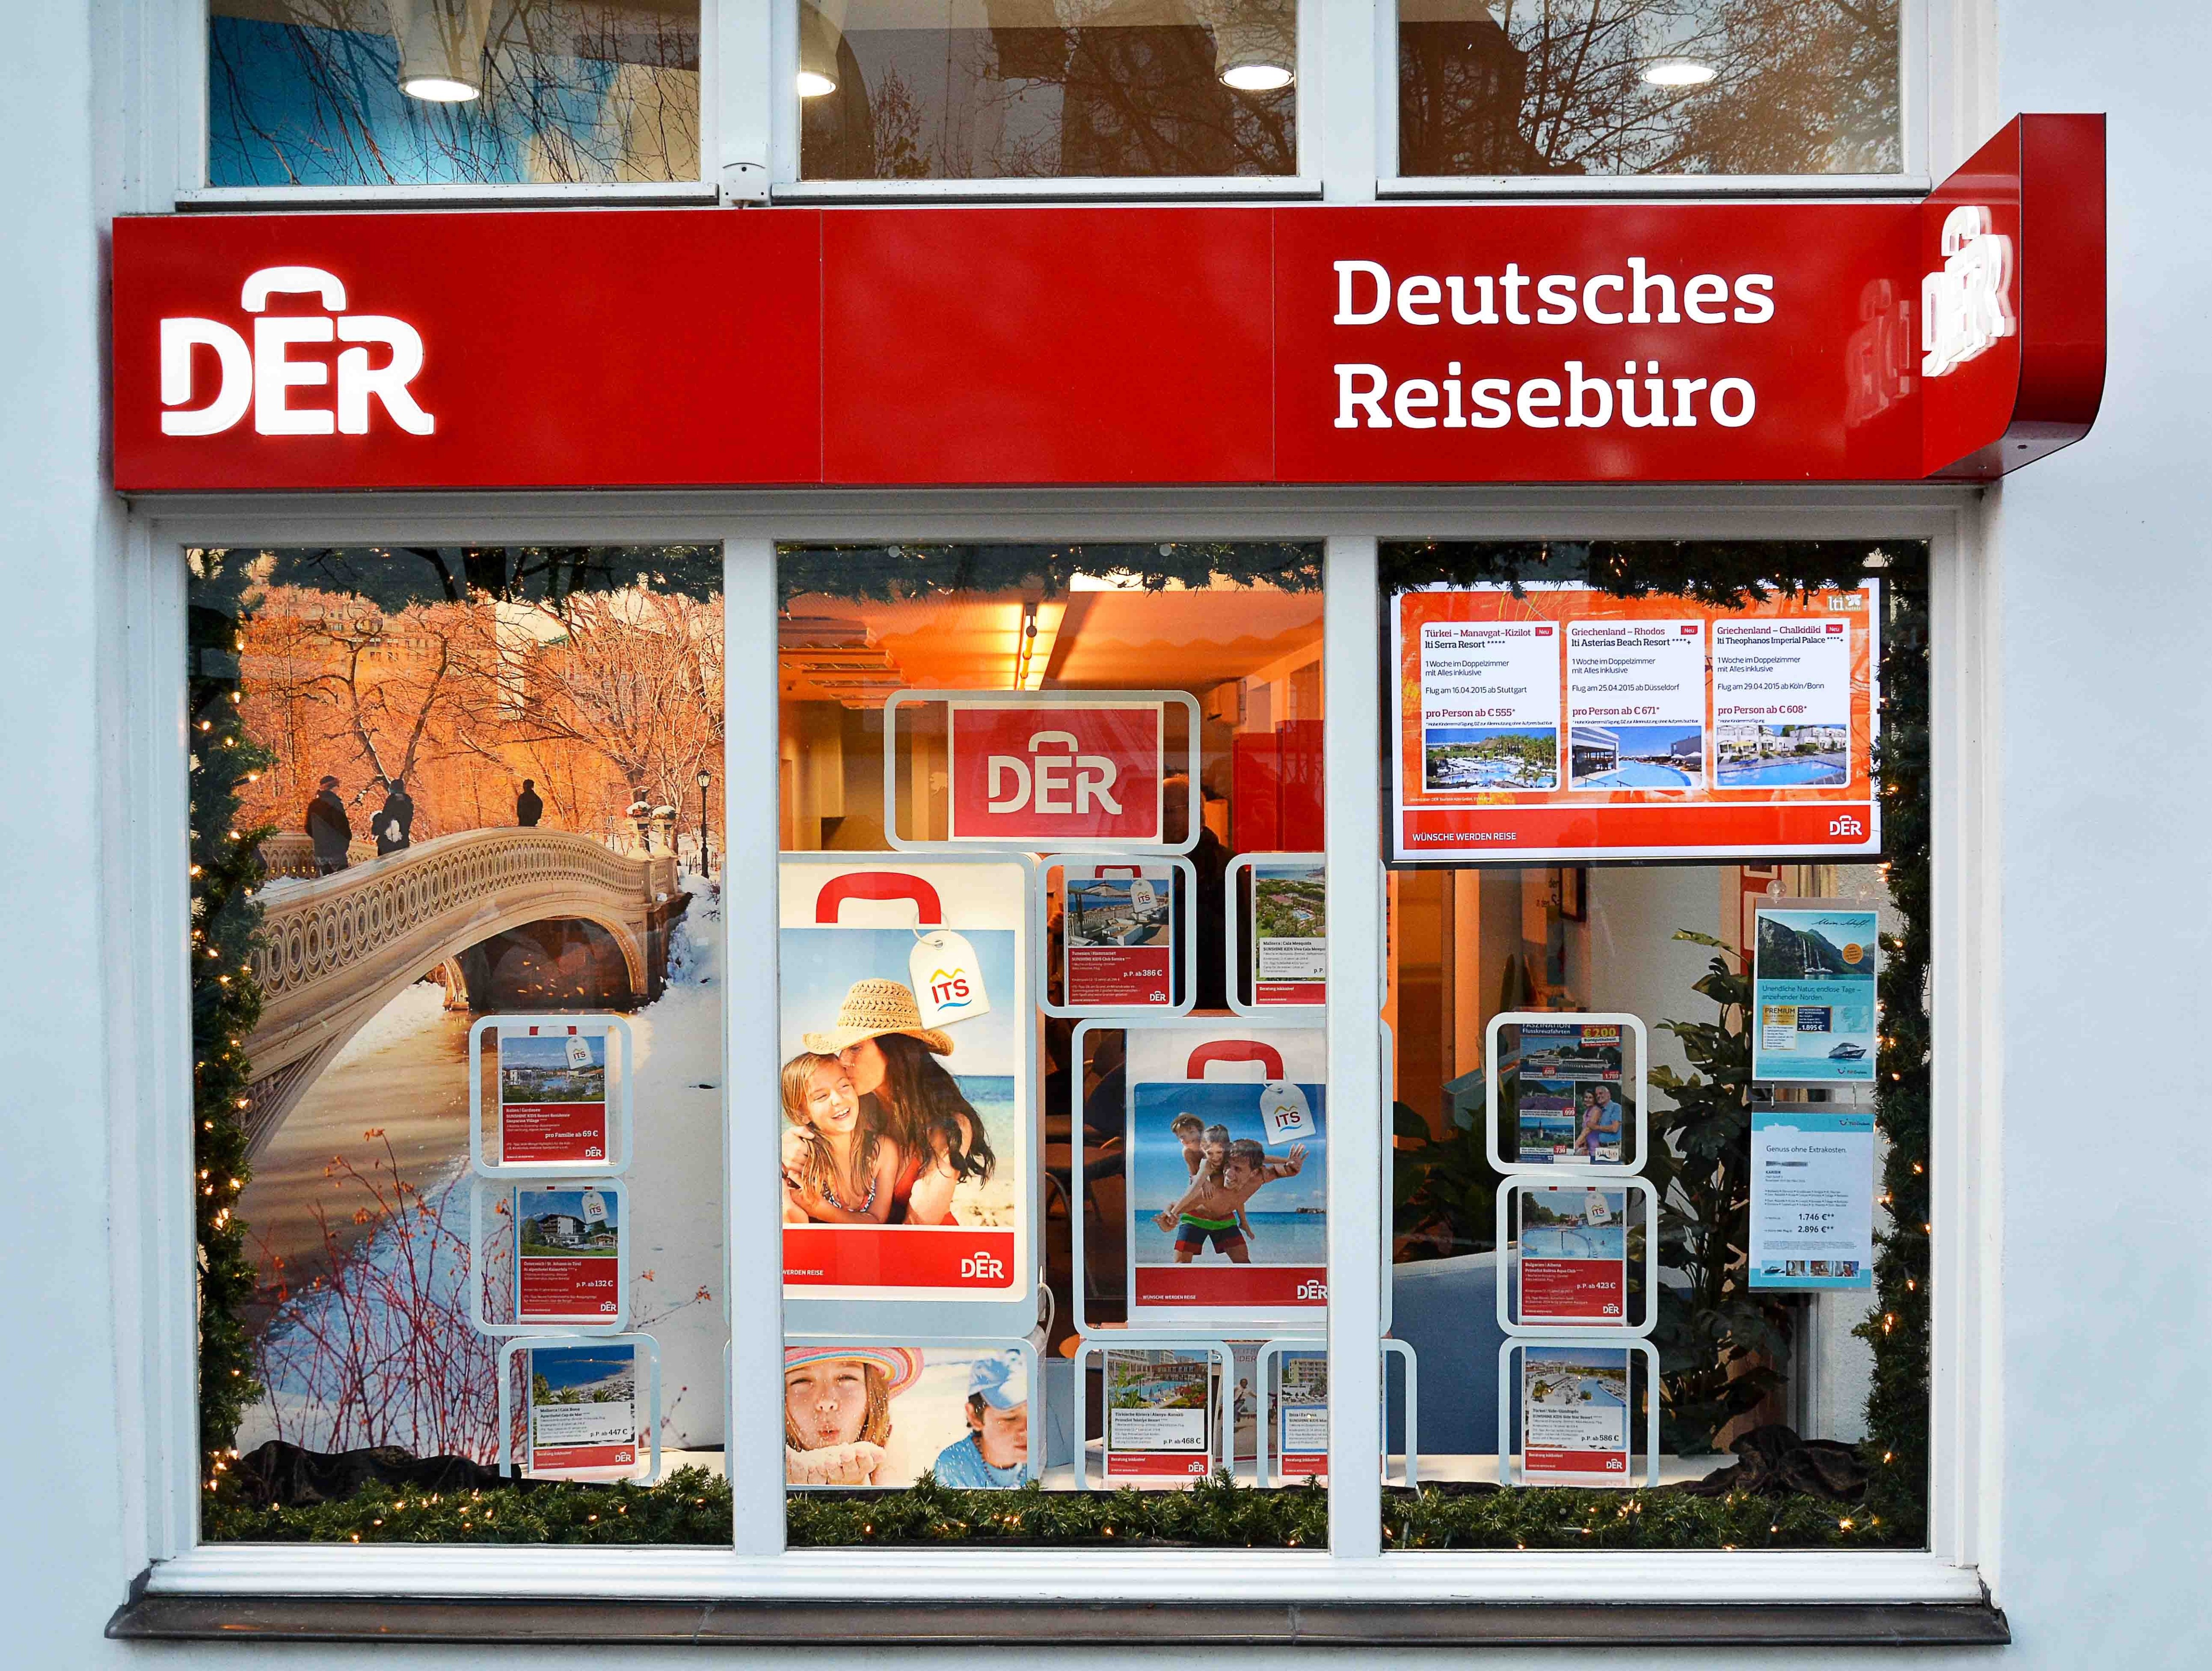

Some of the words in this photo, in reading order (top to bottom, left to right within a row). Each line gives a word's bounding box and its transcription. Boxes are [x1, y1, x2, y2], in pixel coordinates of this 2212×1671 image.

[1333, 257, 1775, 325] Deutsches
[160, 316, 434, 435] DER
[1333, 361, 1756, 428] Reisebüro
[1425, 629, 1452, 637] Türkei
[1725, 637, 1770, 646] Theophanos
[1771, 637, 1801, 645] Imperial
[1497, 686, 1527, 695] Stuttgart
[1717, 683, 1732, 692] Flug
[1442, 709, 1473, 717] Person
[1572, 708, 1587, 717] pro
[988, 756, 1122, 814] DER
[1829, 820, 1862, 836] DER
[1413, 832, 1454, 841] WÜNSCHE
[1138, 894, 1150, 903] ITS
[932, 979, 969, 1003] ITS
[1584, 1028, 1591, 1037] €
[1594, 1028, 1616, 1037] 200
[1275, 1112, 1300, 1127] ITS
[1592, 1208, 1604, 1216] ITS
[961, 1259, 1004, 1278] DER
[1298, 1285, 1328, 1299] DER
